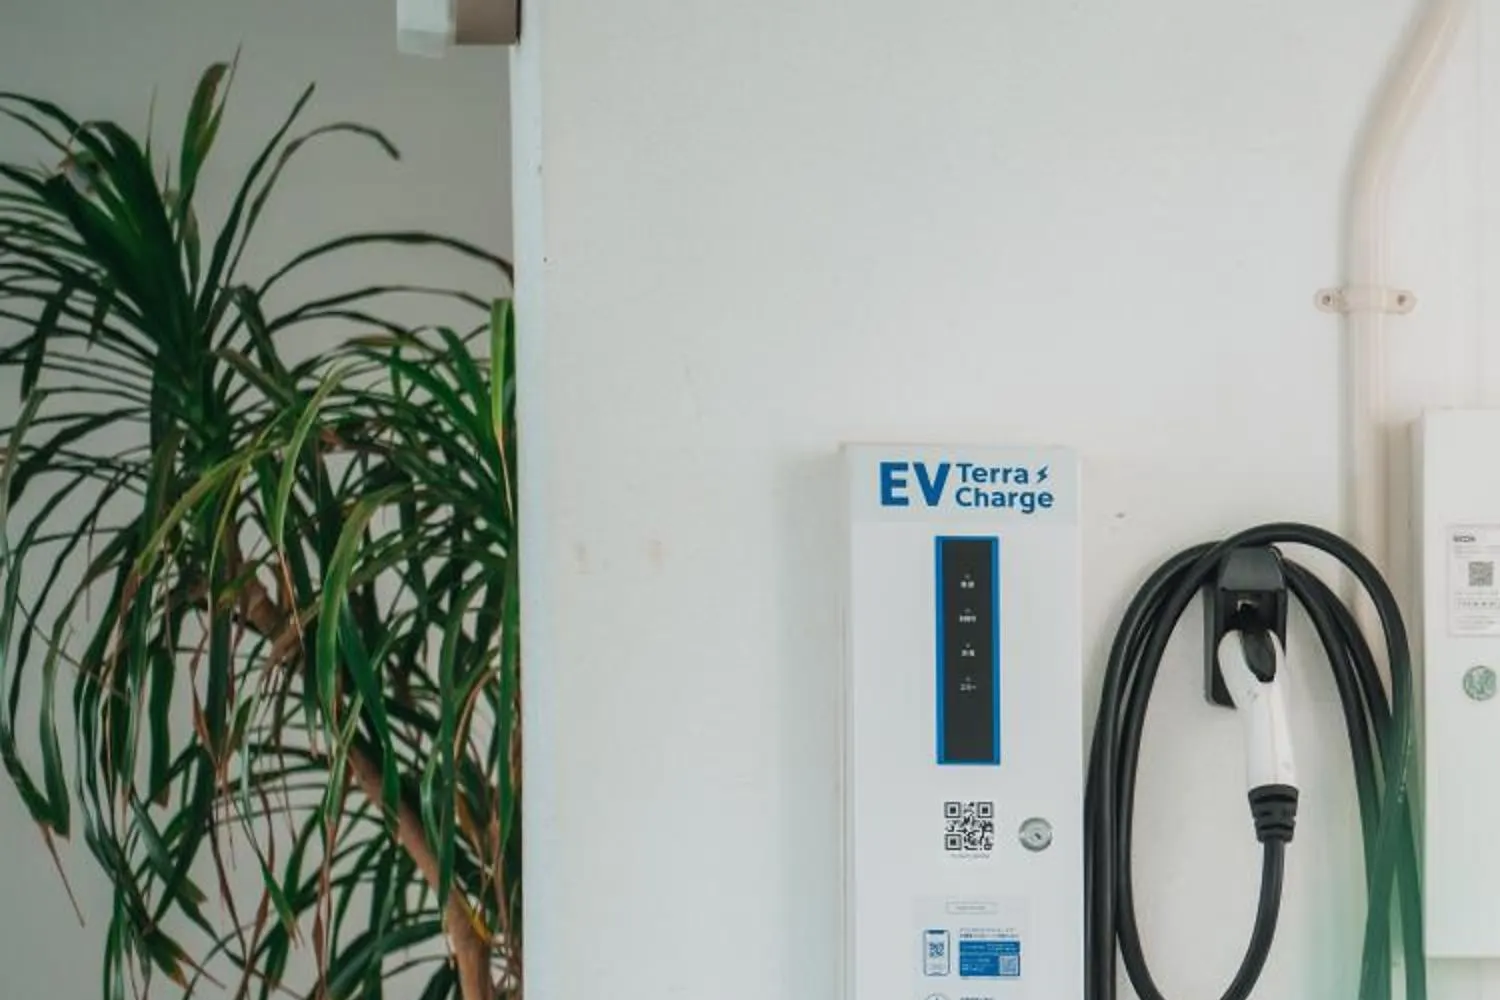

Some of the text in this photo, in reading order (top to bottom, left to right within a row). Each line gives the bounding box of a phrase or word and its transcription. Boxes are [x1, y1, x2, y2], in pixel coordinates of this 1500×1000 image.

[879, 462, 951, 507] EV
[956, 463, 1029, 484] Terra
[955, 487, 1055, 514] Charge
